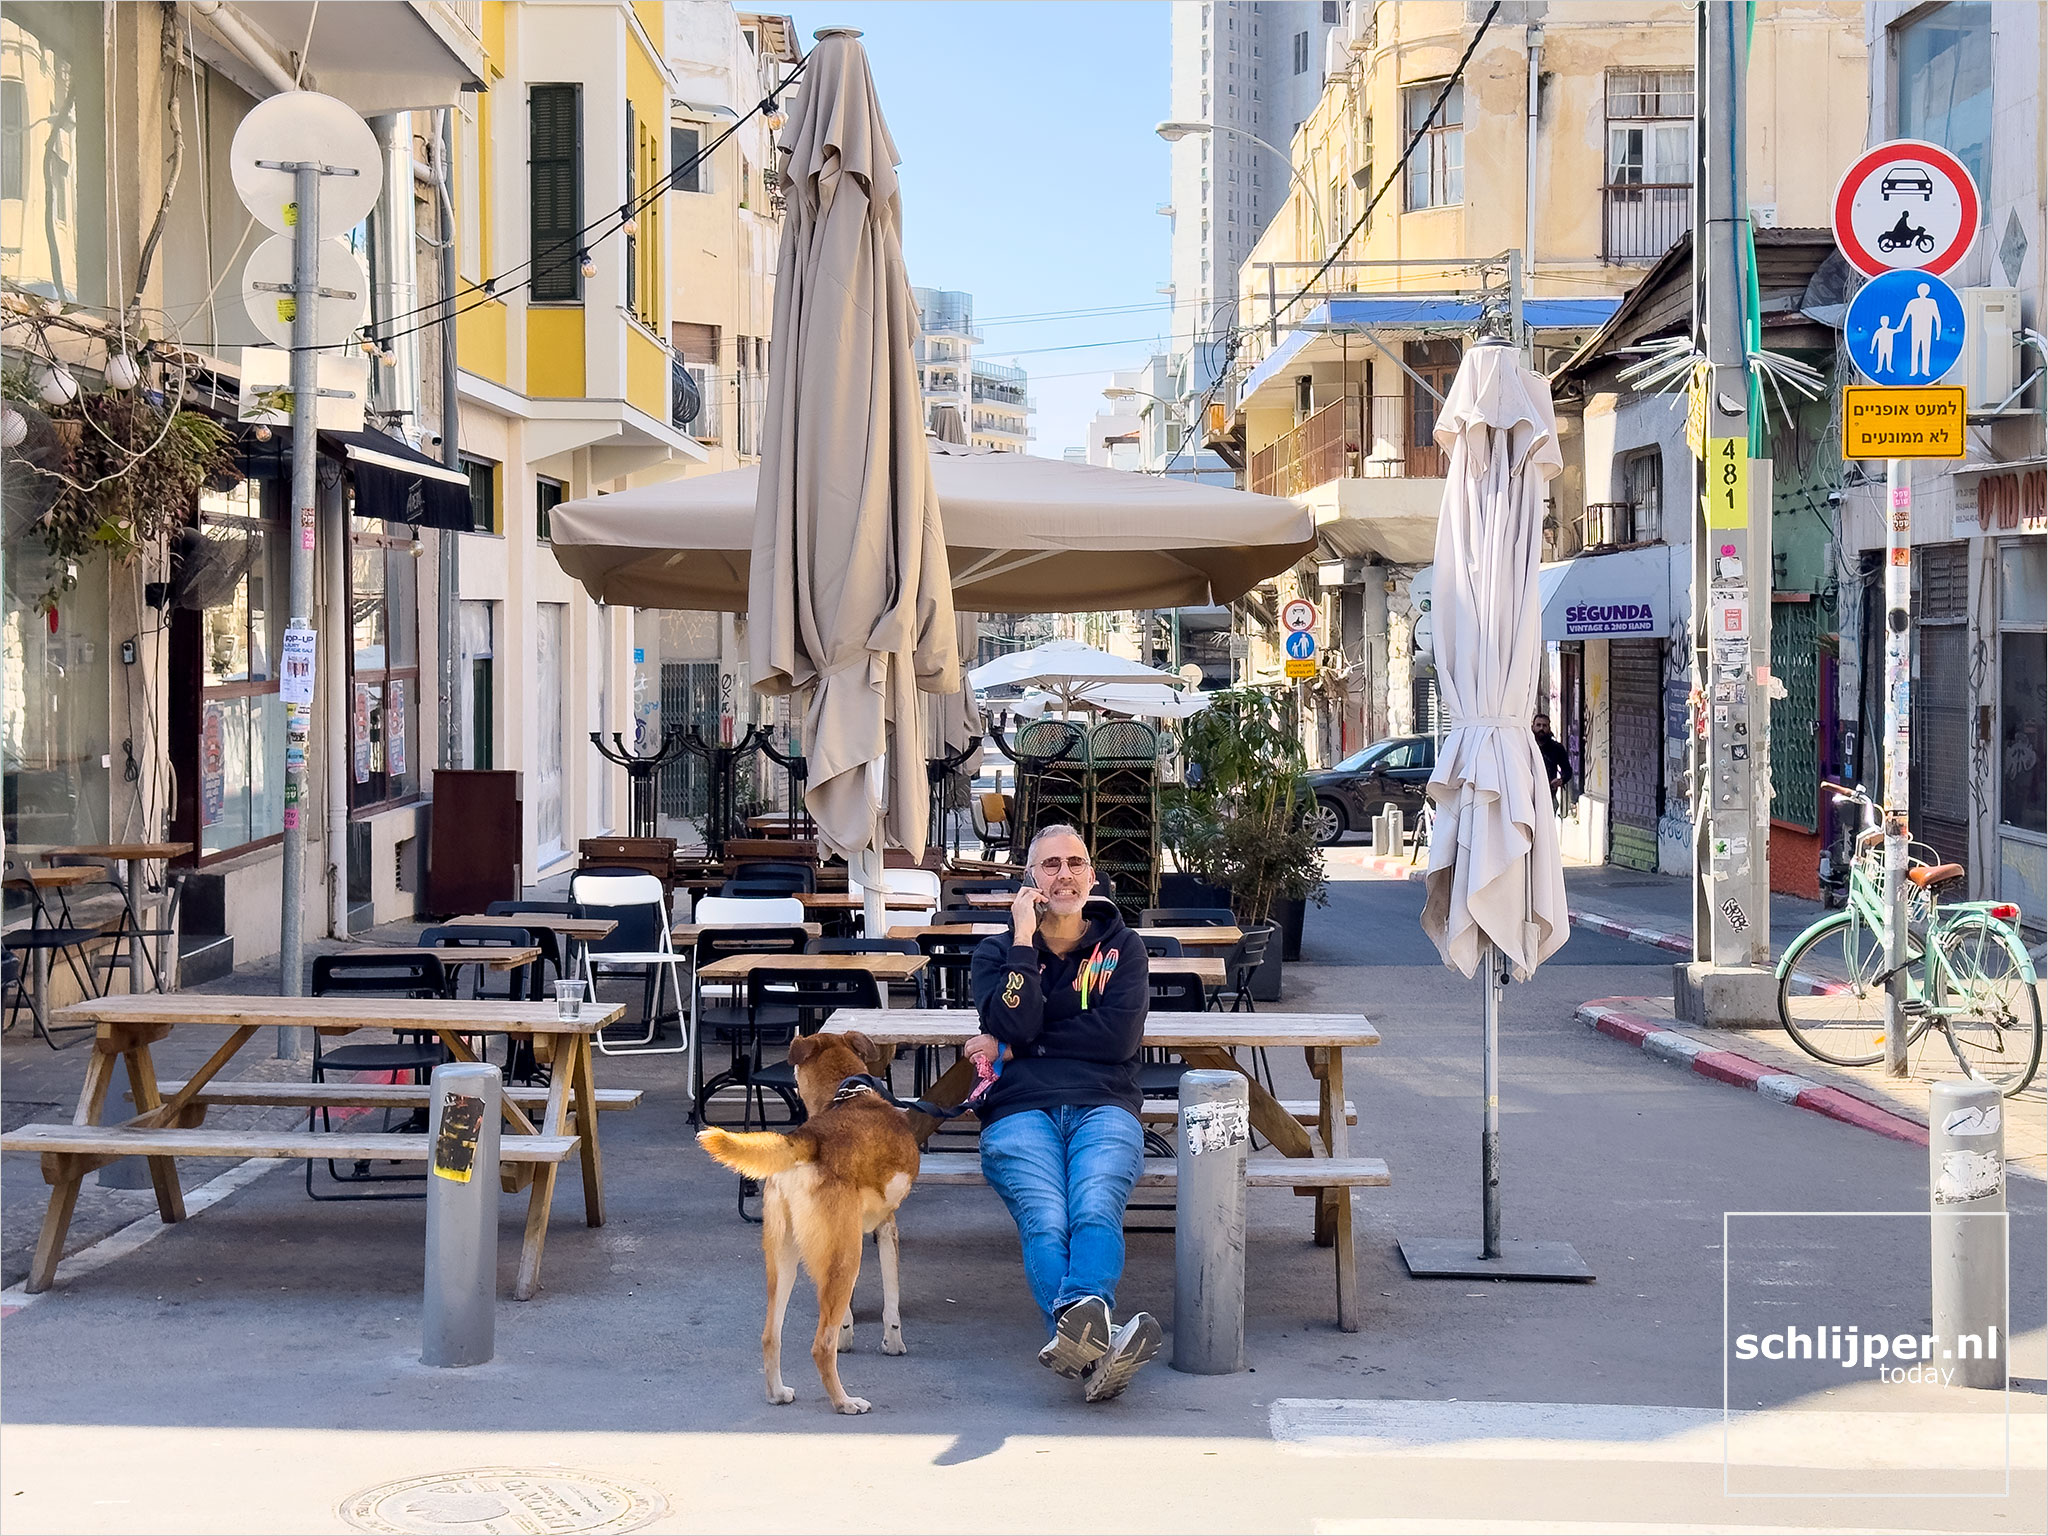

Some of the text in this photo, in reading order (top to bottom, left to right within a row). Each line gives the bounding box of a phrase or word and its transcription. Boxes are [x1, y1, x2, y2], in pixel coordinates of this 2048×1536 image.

[1853, 401, 1957, 416] למעט אופניים
[1861, 428, 1949, 445] לא ממונעים
[1722, 438, 1737, 509] 481
[1569, 621, 1652, 632] VINTAGE & 2ND HAND
